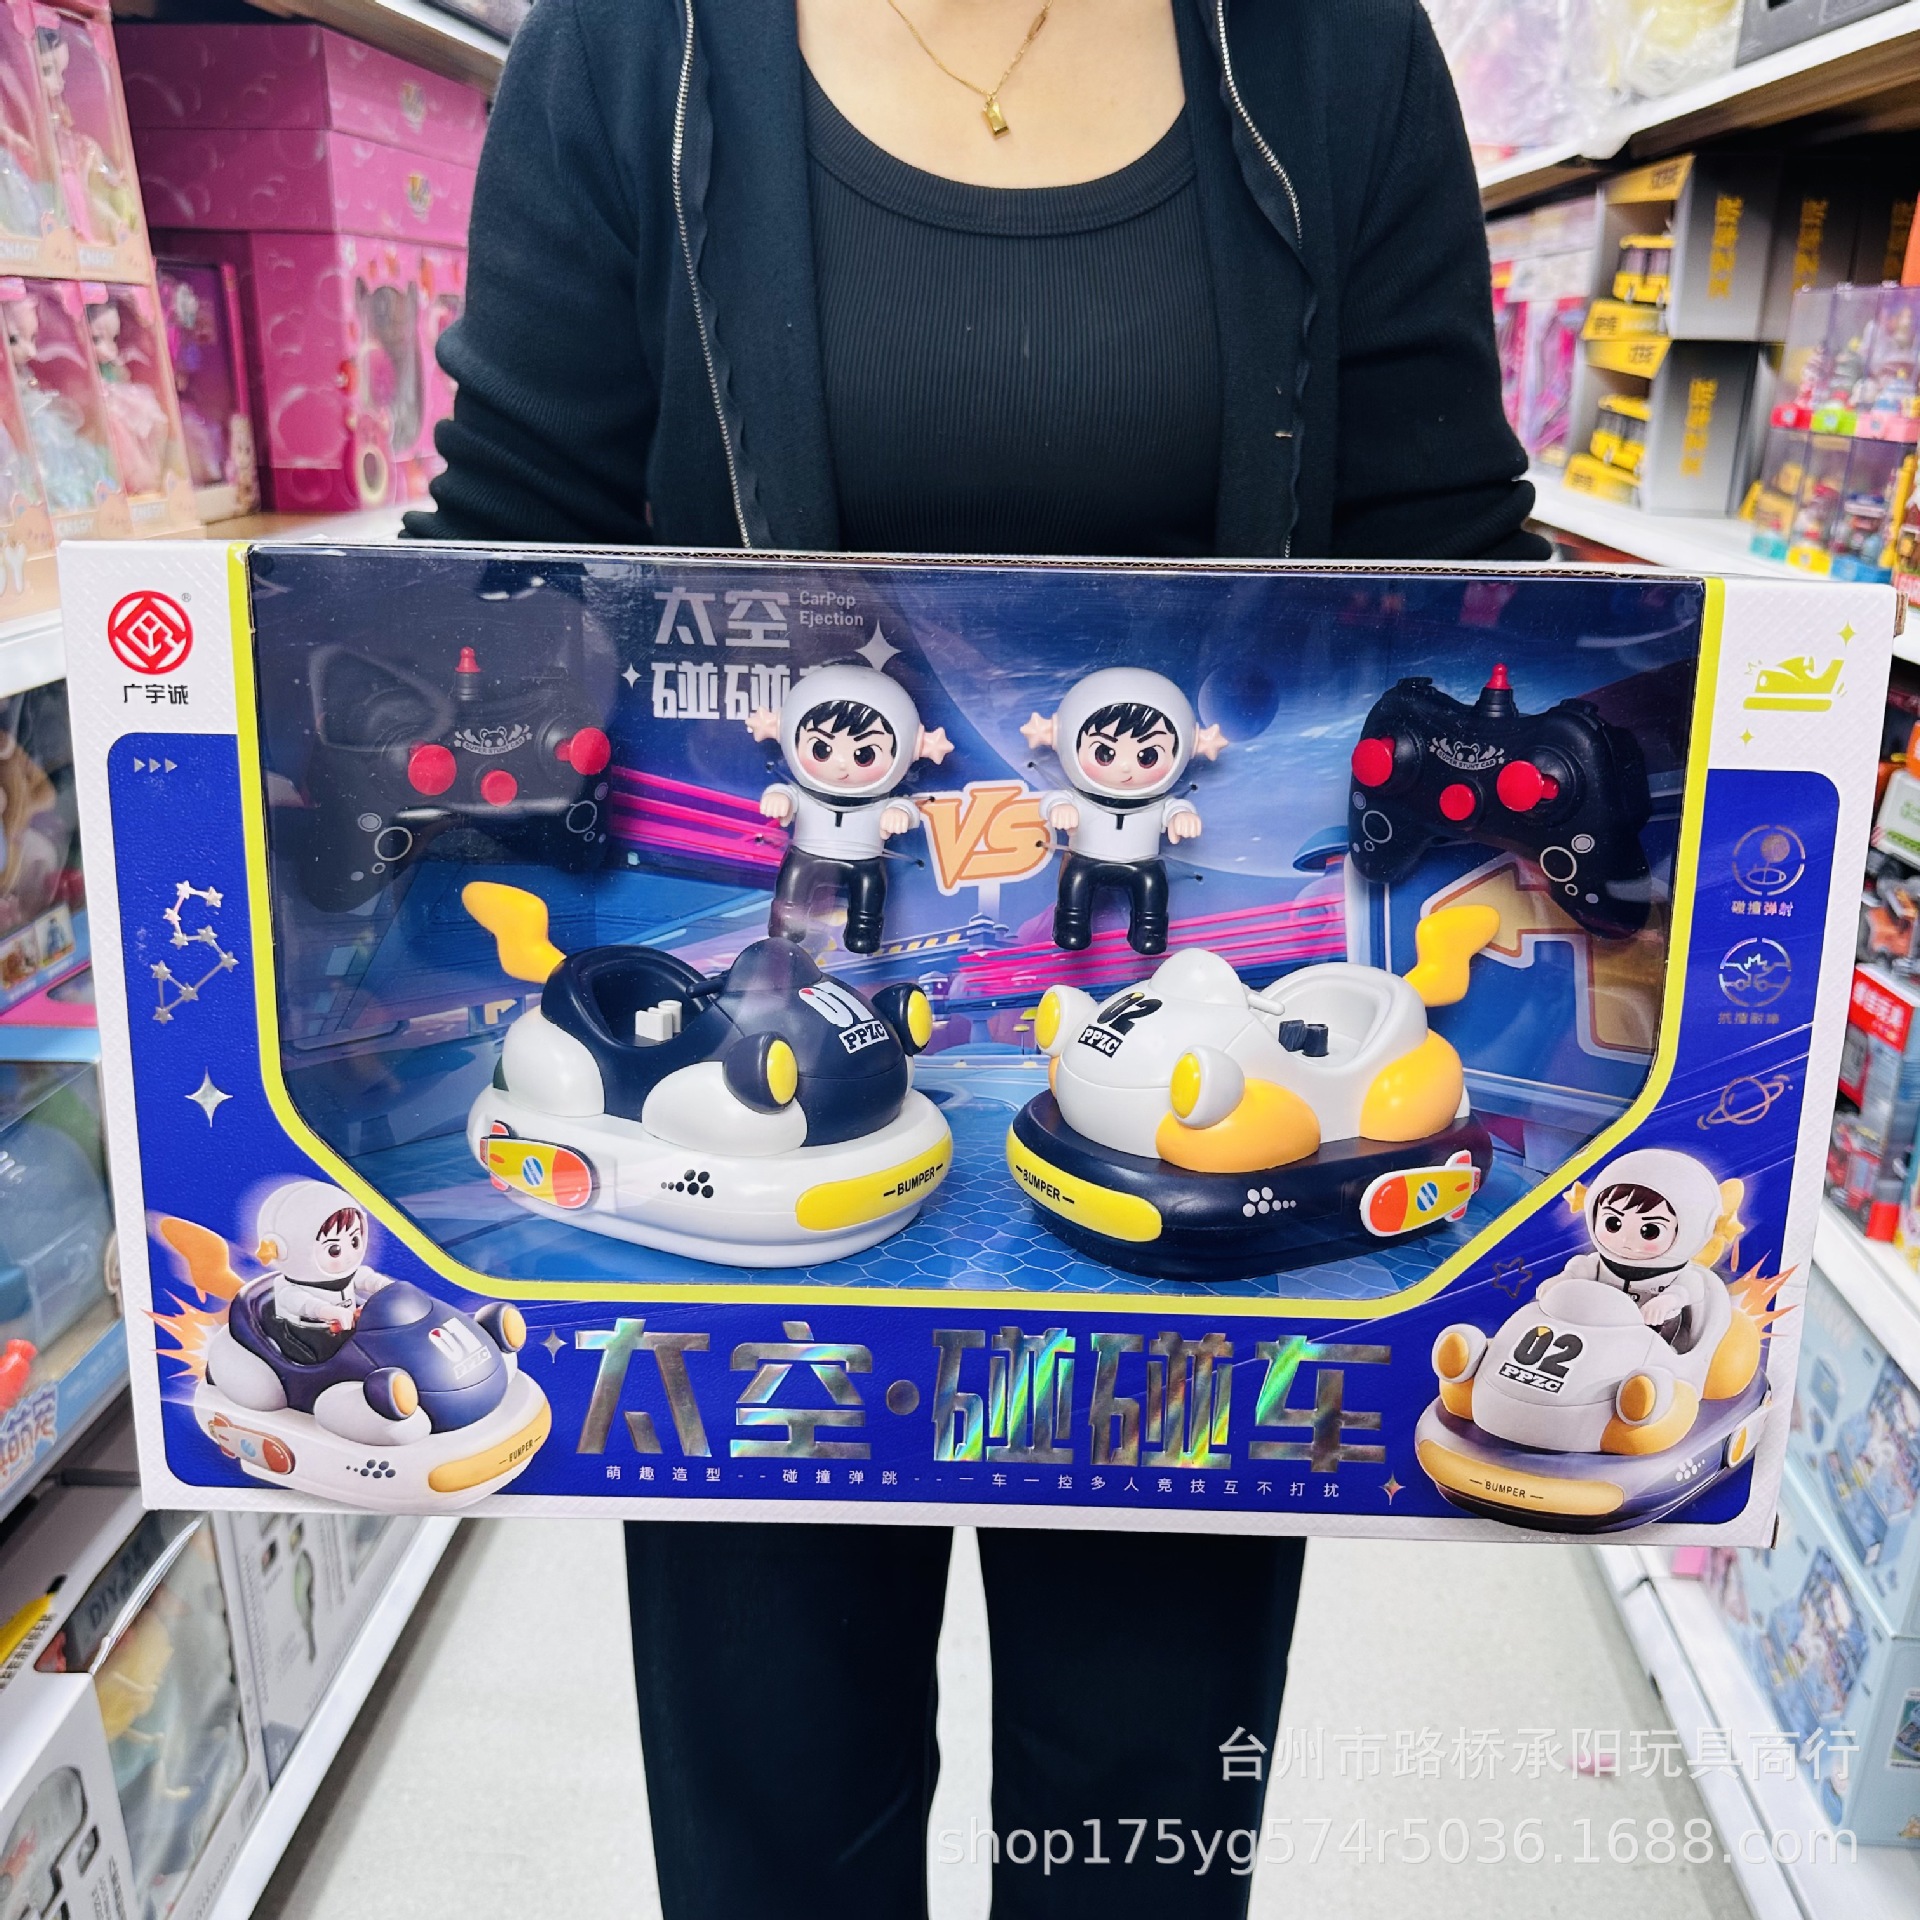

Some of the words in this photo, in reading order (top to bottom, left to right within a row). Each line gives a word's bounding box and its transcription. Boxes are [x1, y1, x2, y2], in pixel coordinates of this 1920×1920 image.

[800, 591, 857, 610] CarPop
[654, 587, 791, 648] 太空
[800, 611, 864, 628] Ejection
[124, 684, 189, 705] 广宇诚
[651, 661, 824, 720] 碰碰
[915, 786, 1051, 889] VS
[1097, 991, 1163, 1037] 02
[842, 1022, 886, 1051] PPZC
[1079, 1027, 1120, 1055] PPZC
[897, 1166, 935, 1197] BUMPER
[1023, 1169, 1060, 1201] BUMPER
[1513, 1325, 1584, 1379] 02
[1501, 1363, 1563, 1393] PPZC
[1484, 1480, 1527, 1498] BUMPER
